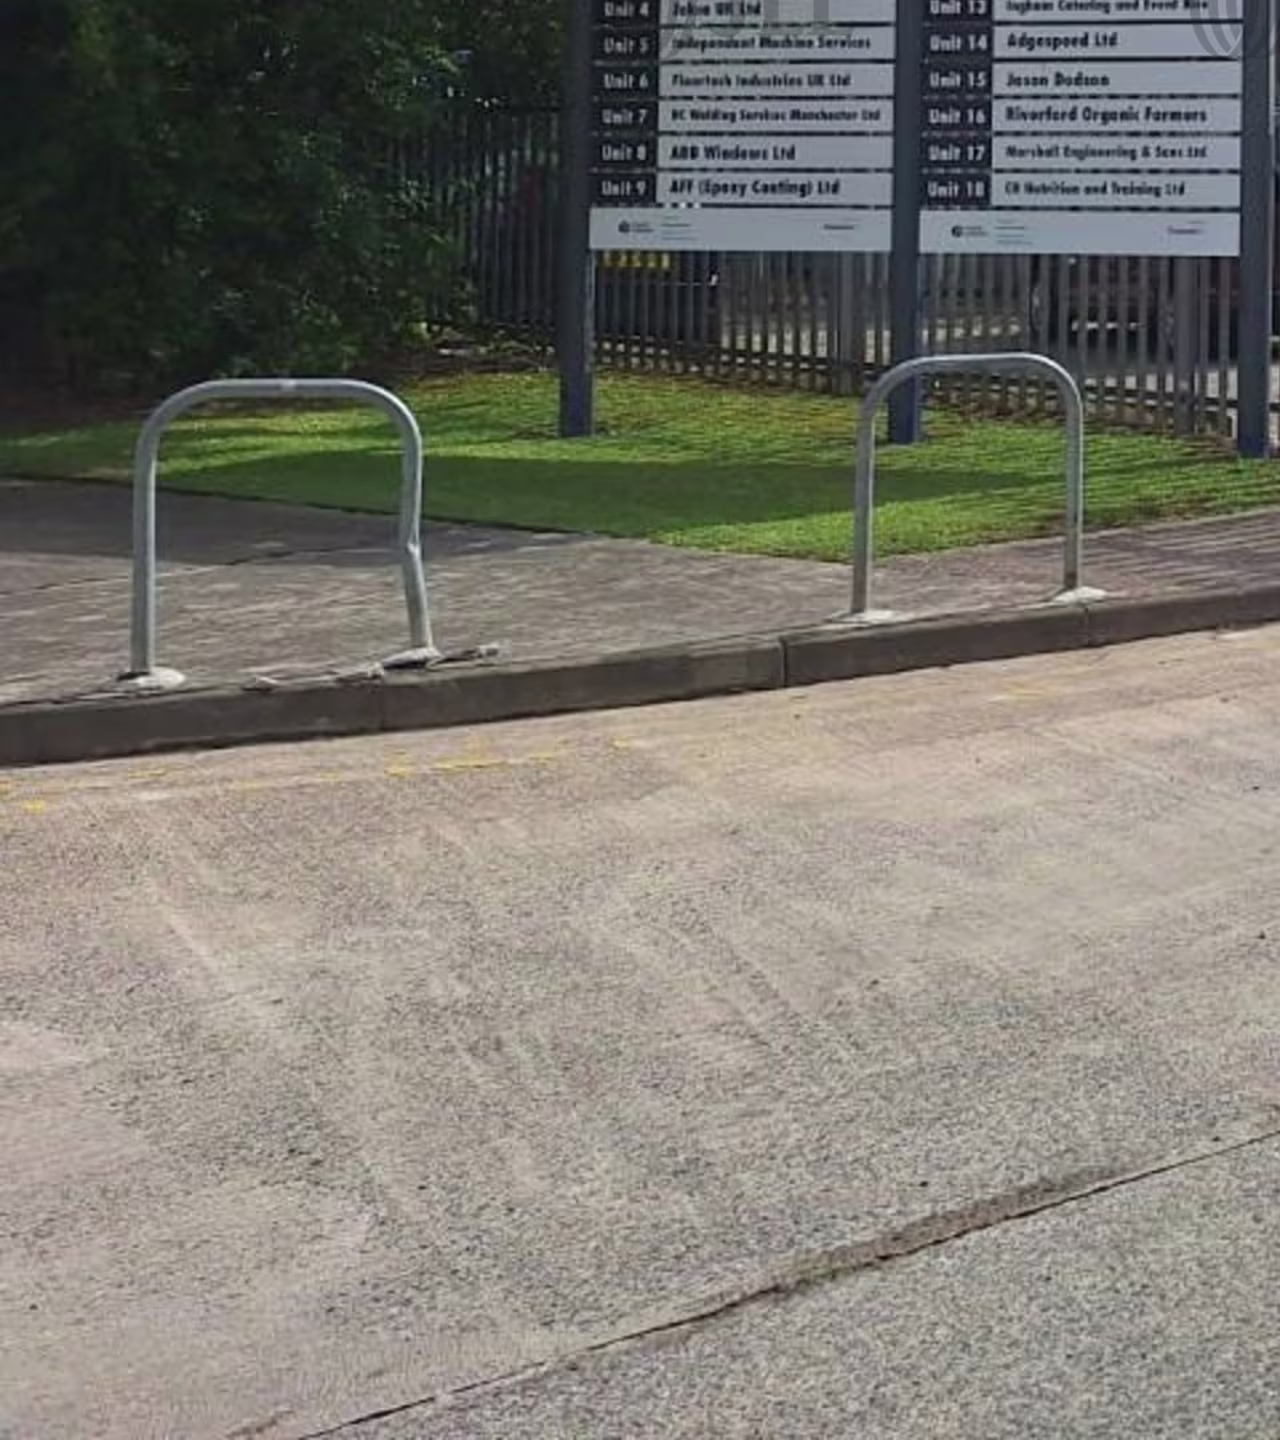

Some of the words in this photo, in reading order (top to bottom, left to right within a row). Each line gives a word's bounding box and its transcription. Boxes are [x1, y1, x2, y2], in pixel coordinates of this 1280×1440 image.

[605, 2, 635, 17] Unit
[639, 1, 649, 16] 4
[740, 0, 761, 15] Ltd
[930, 0, 961, 14] Unit
[968, 0, 987, 14] 13
[604, 37, 636, 53] Unit
[640, 37, 648, 52] 5
[760, 36, 813, 49] Machine
[818, 35, 870, 48] Services
[930, 36, 961, 51] Unit
[968, 35, 988, 51] 14
[1008, 32, 1089, 52] Adgespeed
[1095, 31, 1117, 47] Ltd
[604, 74, 636, 89] Unit
[640, 74, 648, 88] 6
[737, 74, 802, 87] Industries
[807, 74, 824, 86] UK
[830, 73, 851, 86] Ltd
[930, 71, 961, 86] Unit
[967, 71, 986, 86] 15
[1006, 72, 1048, 87] Jason
[602, 109, 634, 124] Unit
[638, 109, 647, 124] 7
[862, 108, 881, 121] Ltd
[929, 108, 961, 123] Unit
[968, 107, 984, 123] 16
[1006, 106, 1078, 122] Riverford
[1083, 106, 1140, 125] Organic
[1145, 106, 1207, 121] Farmers
[602, 145, 633, 160] Unit
[637, 145, 646, 160] 8
[704, 144, 768, 160] Windows
[773, 144, 795, 160] Ltd
[929, 145, 960, 160] Unit
[967, 144, 984, 159] 17
[1006, 145, 1060, 158] Marshall
[1064, 144, 1137, 160] Engineering
[1142, 145, 1150, 158] &
[1187, 144, 1207, 158] Ltd
[602, 180, 633, 195] Unit
[637, 180, 646, 195] 9
[699, 180, 746, 196] (Epoxy
[752, 179, 812, 197] Coating)
[817, 179, 839, 194] Ltd
[927, 181, 959, 197] Unit
[966, 181, 984, 197] 18
[1024, 181, 1080, 194] Nutrition
[1084, 181, 1107, 194] and
[1112, 180, 1161, 197] Training
[1165, 180, 1185, 194] Ltd
